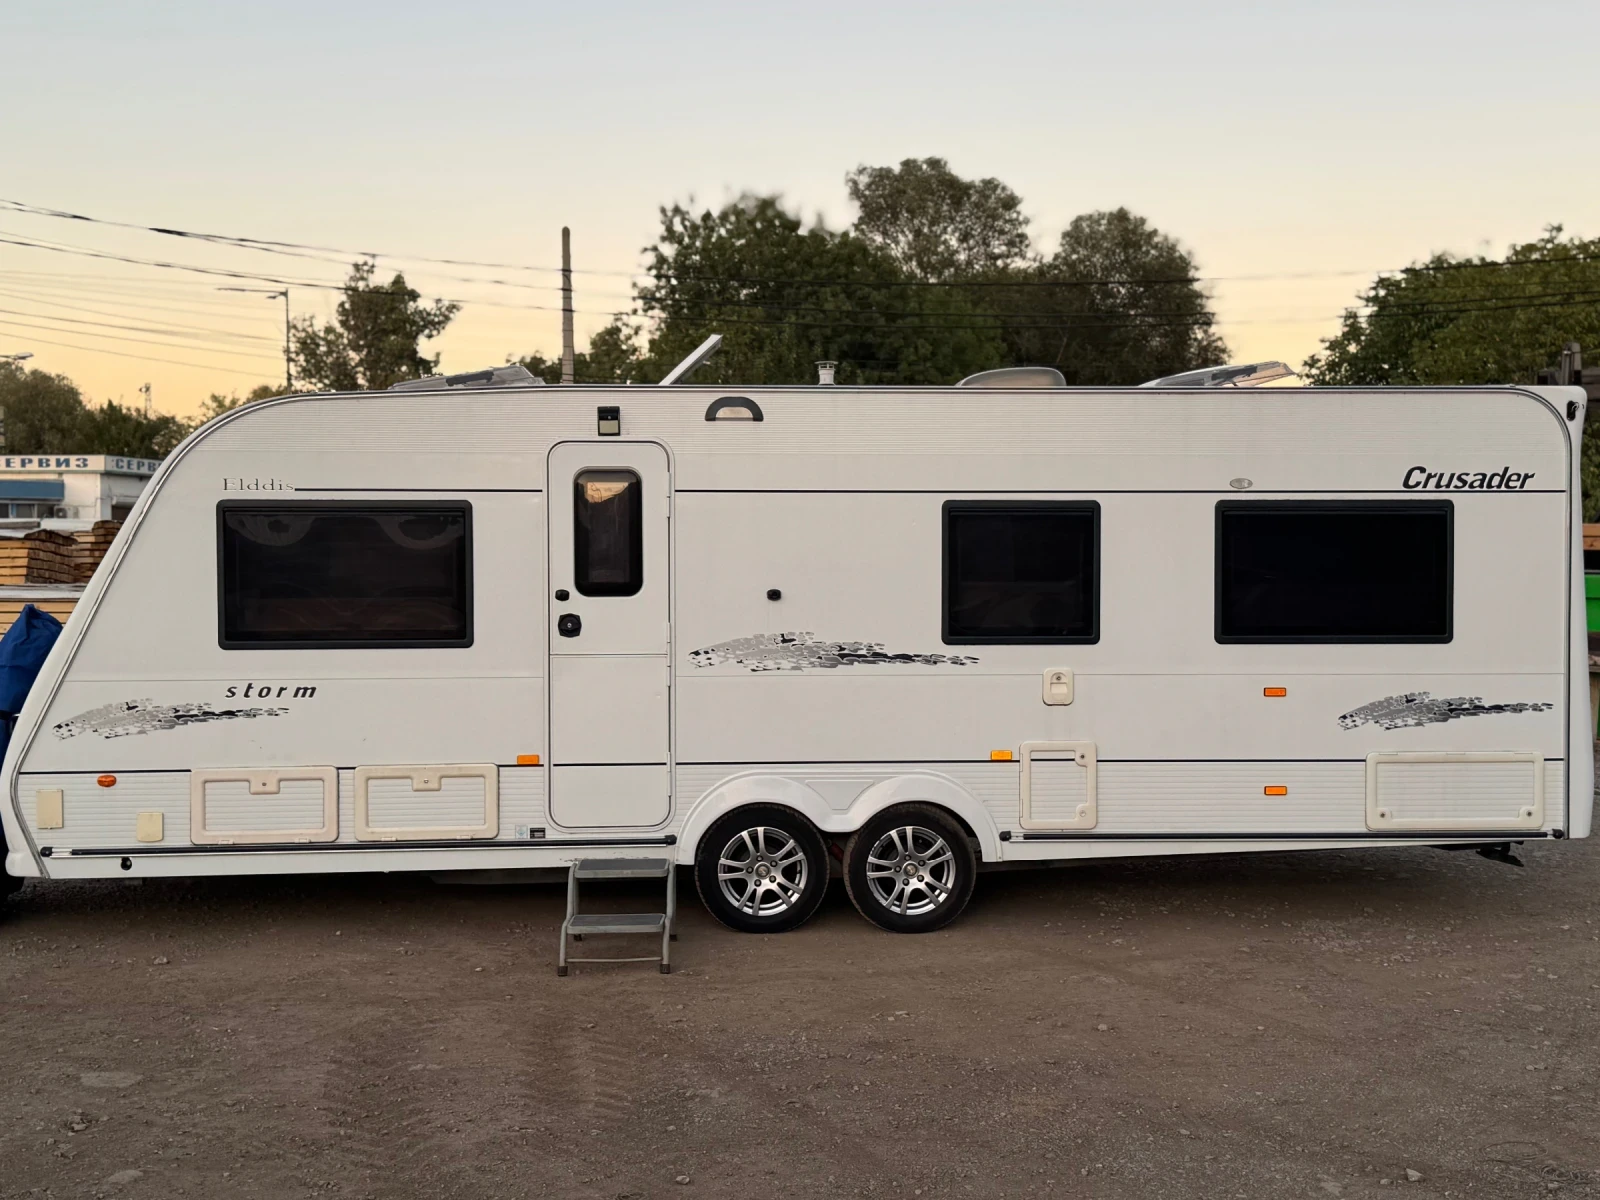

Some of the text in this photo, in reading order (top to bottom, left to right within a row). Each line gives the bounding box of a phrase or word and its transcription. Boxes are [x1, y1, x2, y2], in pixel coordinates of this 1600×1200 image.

[0, 457, 89, 469] ЕРВИЗ
[115, 458, 163, 472] СЕРВ
[222, 478, 294, 491] Elddis
[1402, 466, 1535, 489] Crusader
[225, 682, 317, 698] storm
